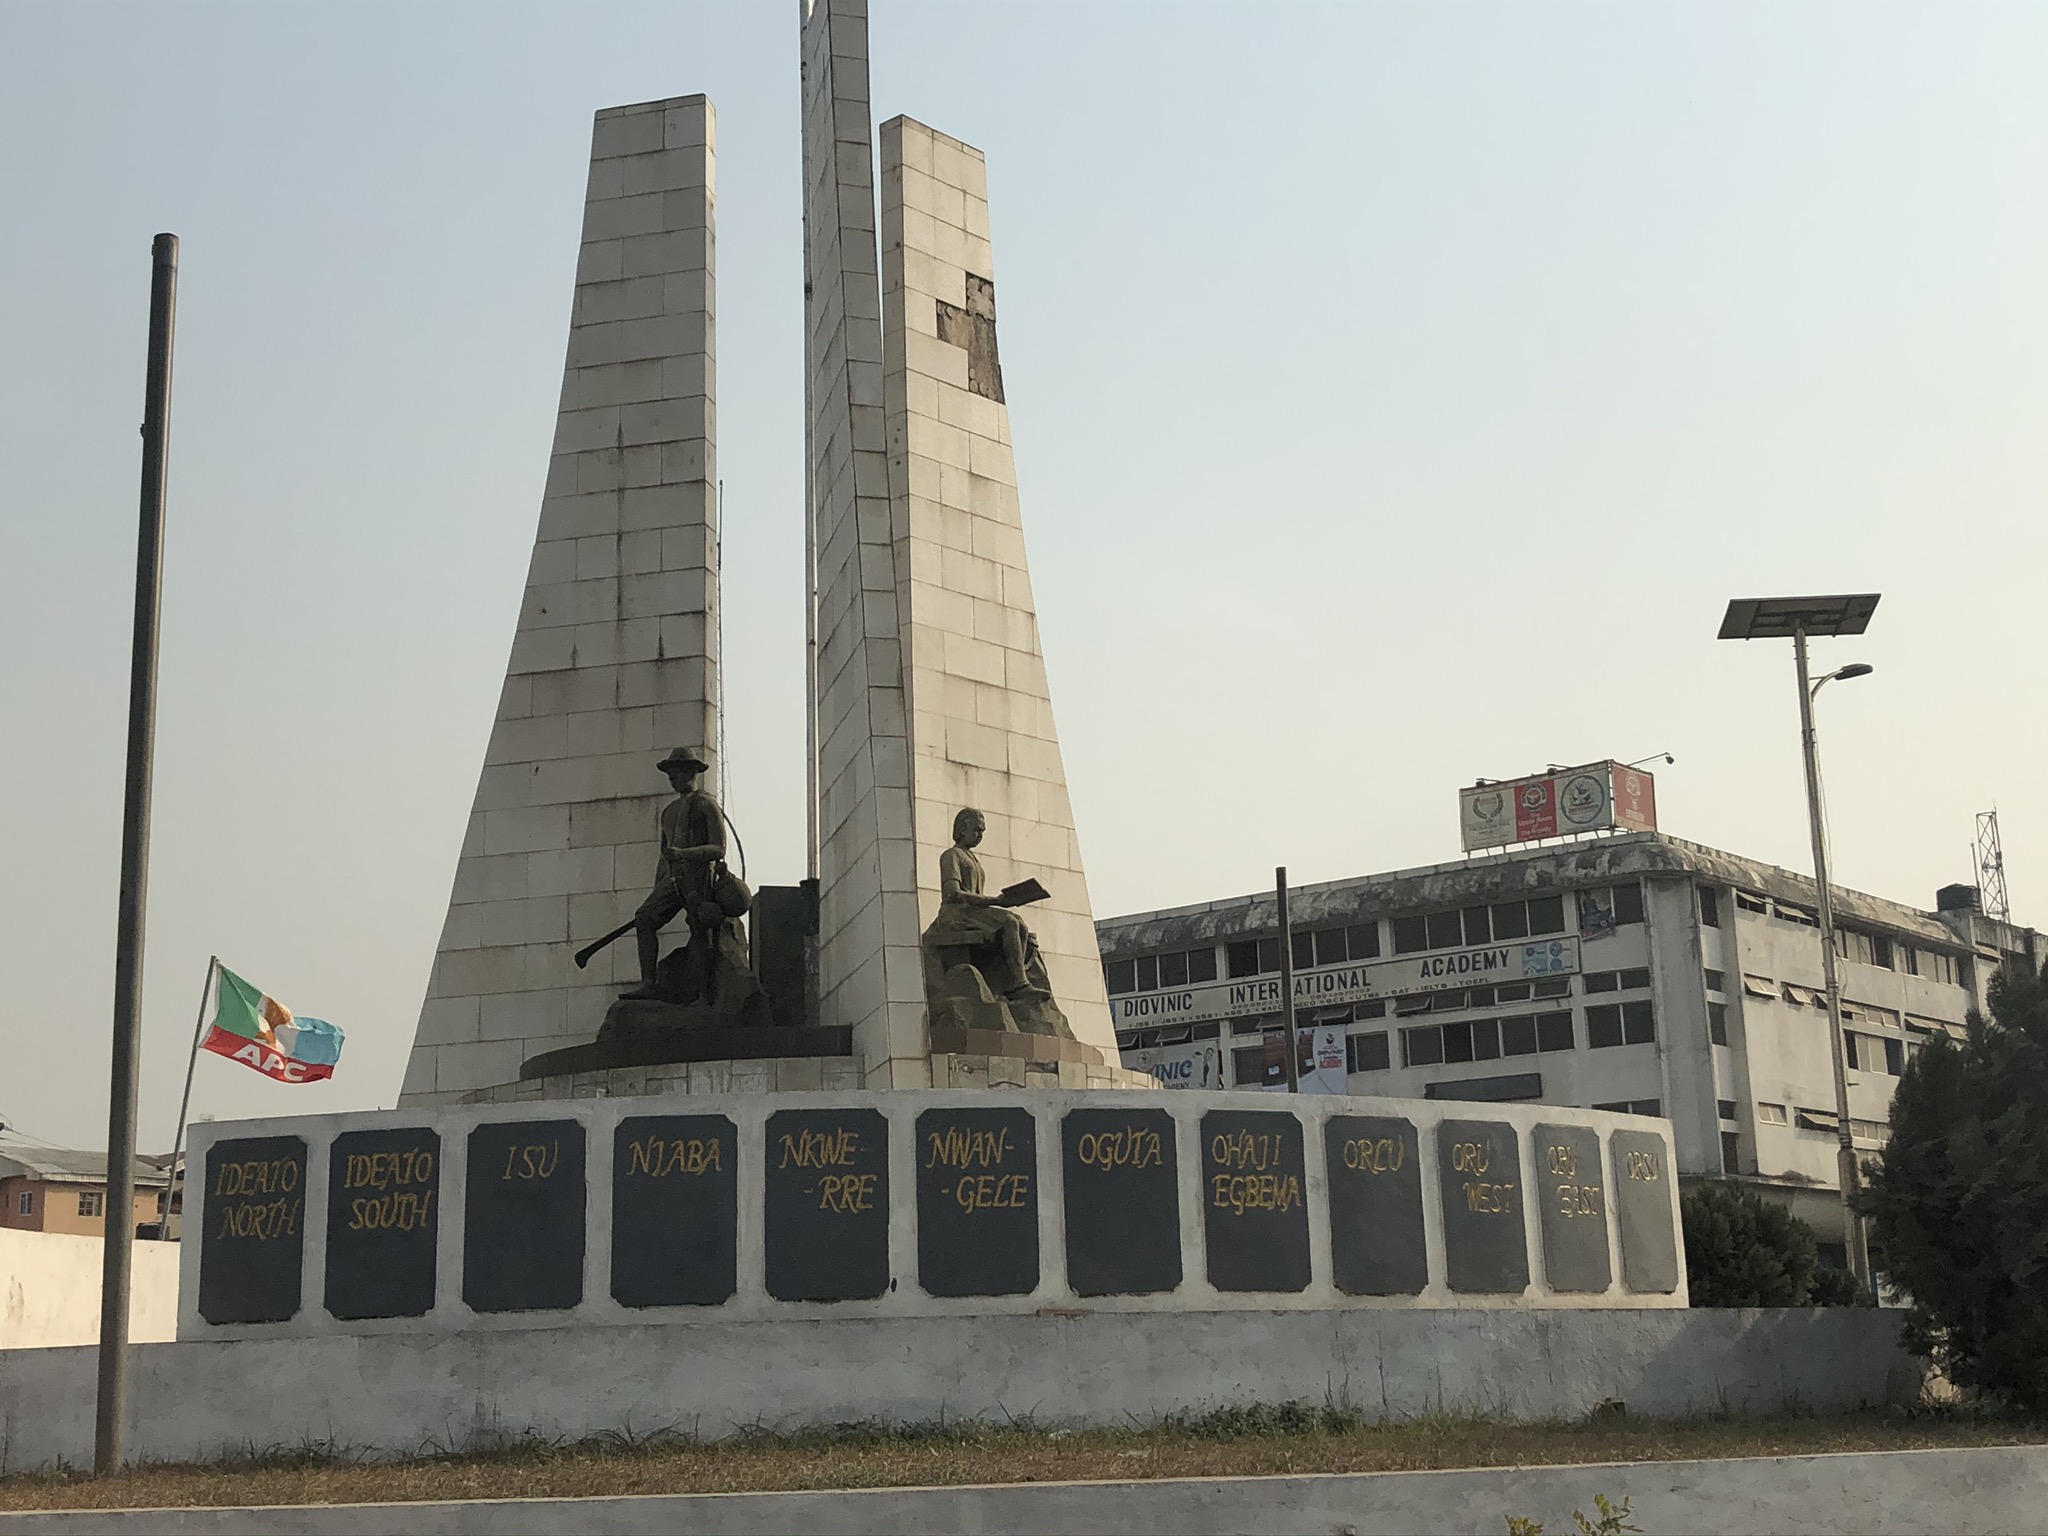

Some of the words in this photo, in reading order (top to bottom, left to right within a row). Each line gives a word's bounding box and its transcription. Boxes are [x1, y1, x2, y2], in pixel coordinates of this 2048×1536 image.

[1124, 993, 1193, 1018] DIOVINIC
[1230, 968, 1372, 1005] INTERATIONAL
[1420, 949, 1510, 979] ACADEMY
[1355, 992, 1380, 1000] UTME
[1420, 982, 1448, 992] IELTS
[1458, 978, 1490, 986] TOEFL
[231, 1043, 307, 1081] APC
[501, 1139, 559, 1180] ISU
[625, 1135, 723, 1178] NJABA
[1078, 1124, 1164, 1171] OGUTA
[1211, 1127, 1283, 1171] OHAJI
[1451, 1139, 1491, 1177] ORU
[1547, 1142, 1578, 1179] ORU
[215, 1157, 299, 1197] IDEATO
[344, 1149, 433, 1189] IDEATO
[349, 1194, 430, 1232] SOUTH
[1211, 1173, 1302, 1216] EGBEMA
[1462, 1181, 1515, 1214] WEST
[1556, 1183, 1600, 1218] EAST
[218, 1197, 301, 1240] NORTH
